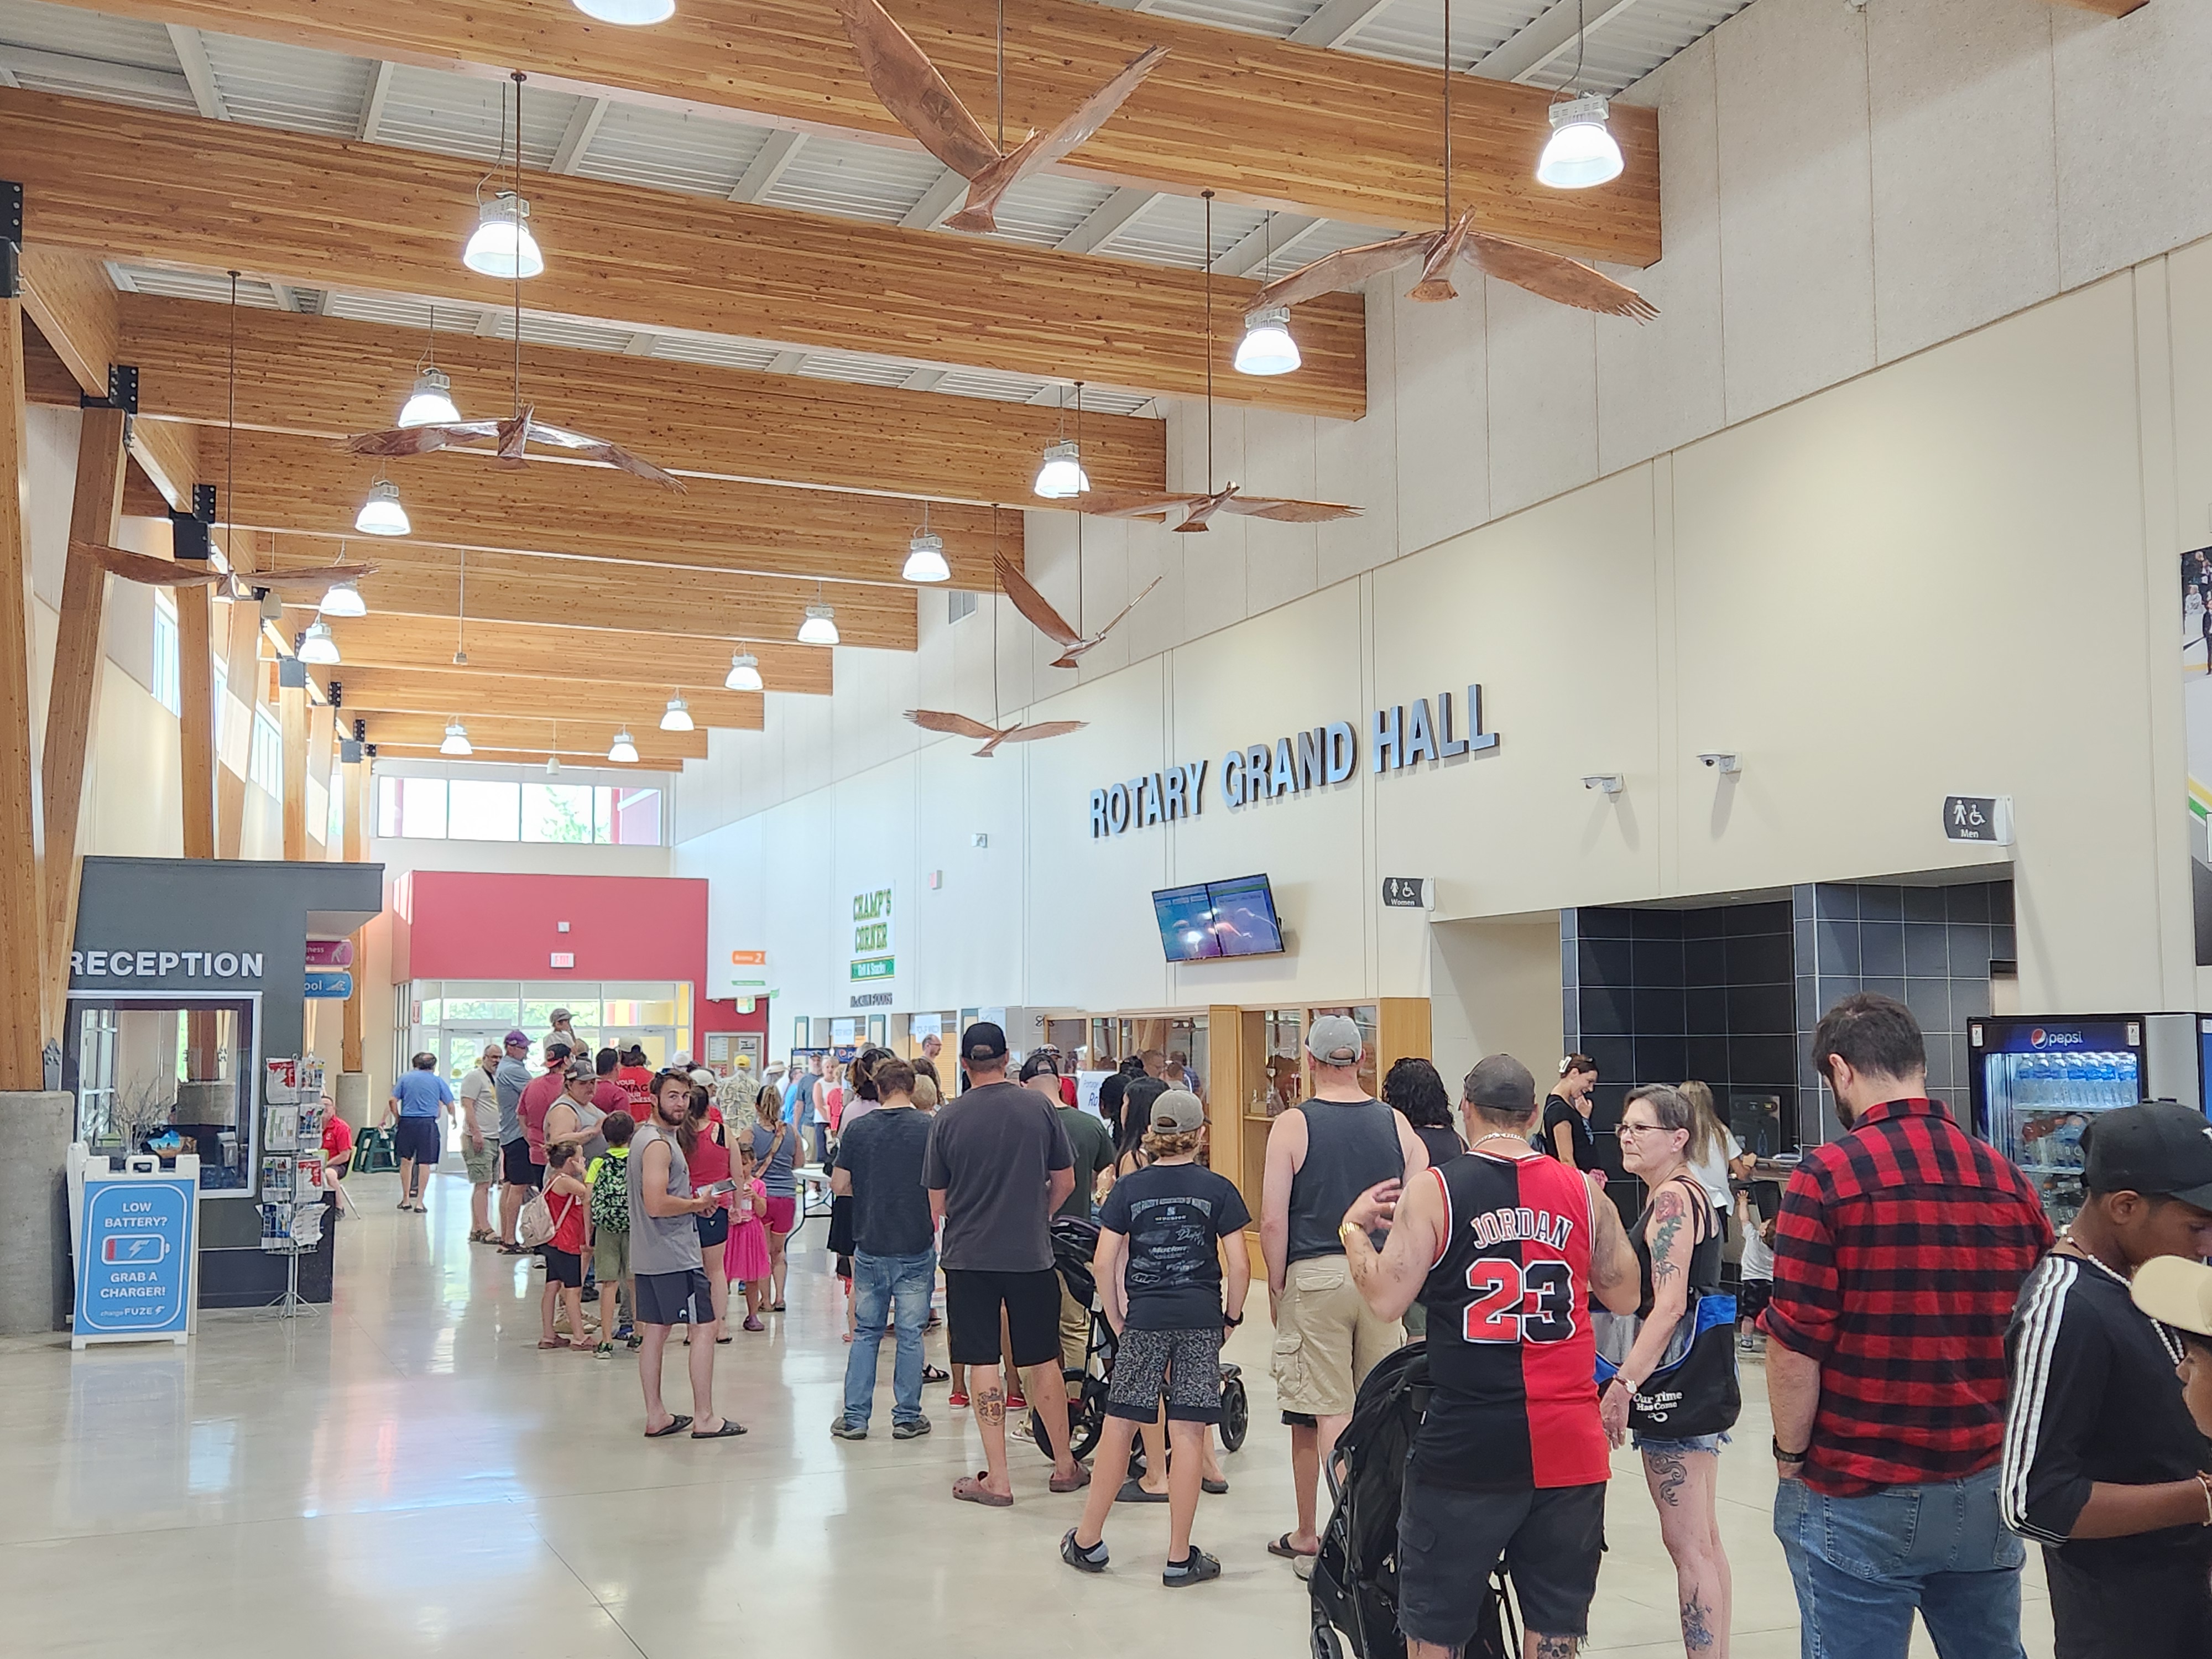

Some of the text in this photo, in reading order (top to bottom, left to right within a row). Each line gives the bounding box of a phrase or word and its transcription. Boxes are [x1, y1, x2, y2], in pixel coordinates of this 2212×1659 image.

[1090, 684, 1500, 838] ROTARY GRAND HALL
[1960, 829, 1979, 838] Men
[853, 888, 891, 922] CHAMP'S
[855, 922, 887, 953] CORNER
[70, 951, 263, 977] RECEPTION
[755, 953, 762, 963] 2
[304, 980, 322, 990] ool
[2049, 1031, 2083, 1046] pepsi
[123, 1202, 152, 1212] LOW
[105, 1217, 168, 1228] BATTERY?
[1470, 1208, 1573, 1251] JORDAN
[111, 1272, 158, 1282] GRAB A
[100, 1287, 165, 1298] CHARGER!
[1463, 1258, 1575, 1344] 23
[1633, 1391, 1683, 1404] Our Time
[1654, 1401, 1677, 1410] Come
